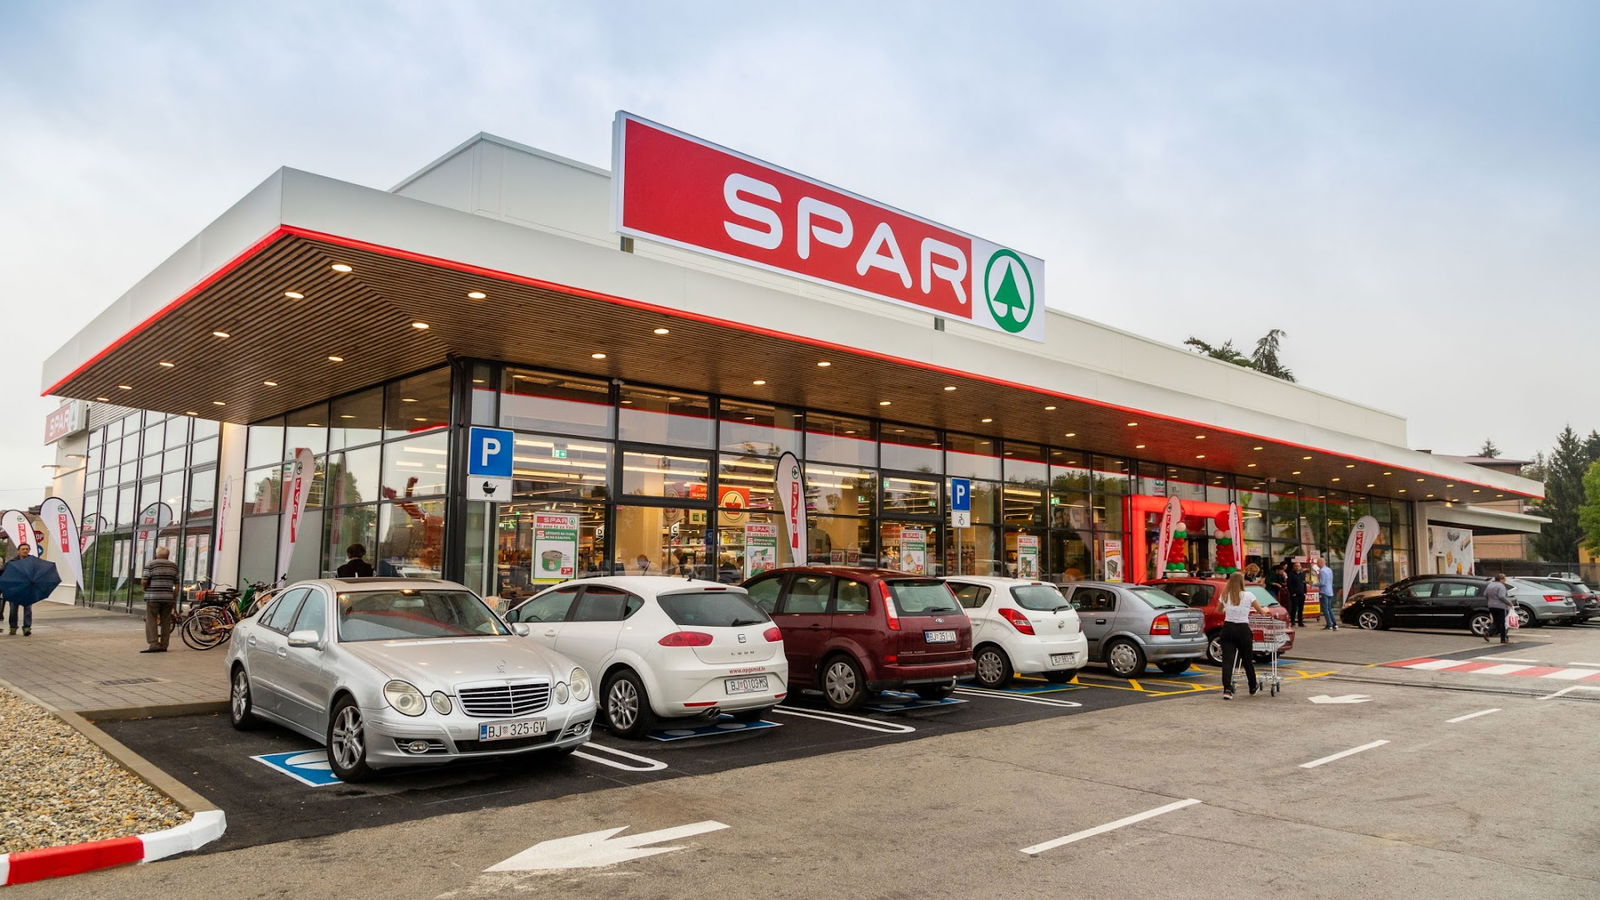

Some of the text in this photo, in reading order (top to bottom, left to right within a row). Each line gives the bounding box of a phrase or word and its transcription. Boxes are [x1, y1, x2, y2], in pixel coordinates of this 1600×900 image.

[723, 173, 967, 304] SPAR
[49, 408, 70, 437] SPAR
[481, 437, 501, 467] P
[956, 485, 966, 505] P
[544, 516, 568, 524] SPAR
[731, 681, 740, 691] BJ
[488, 721, 545, 738] BJ 325-GV
